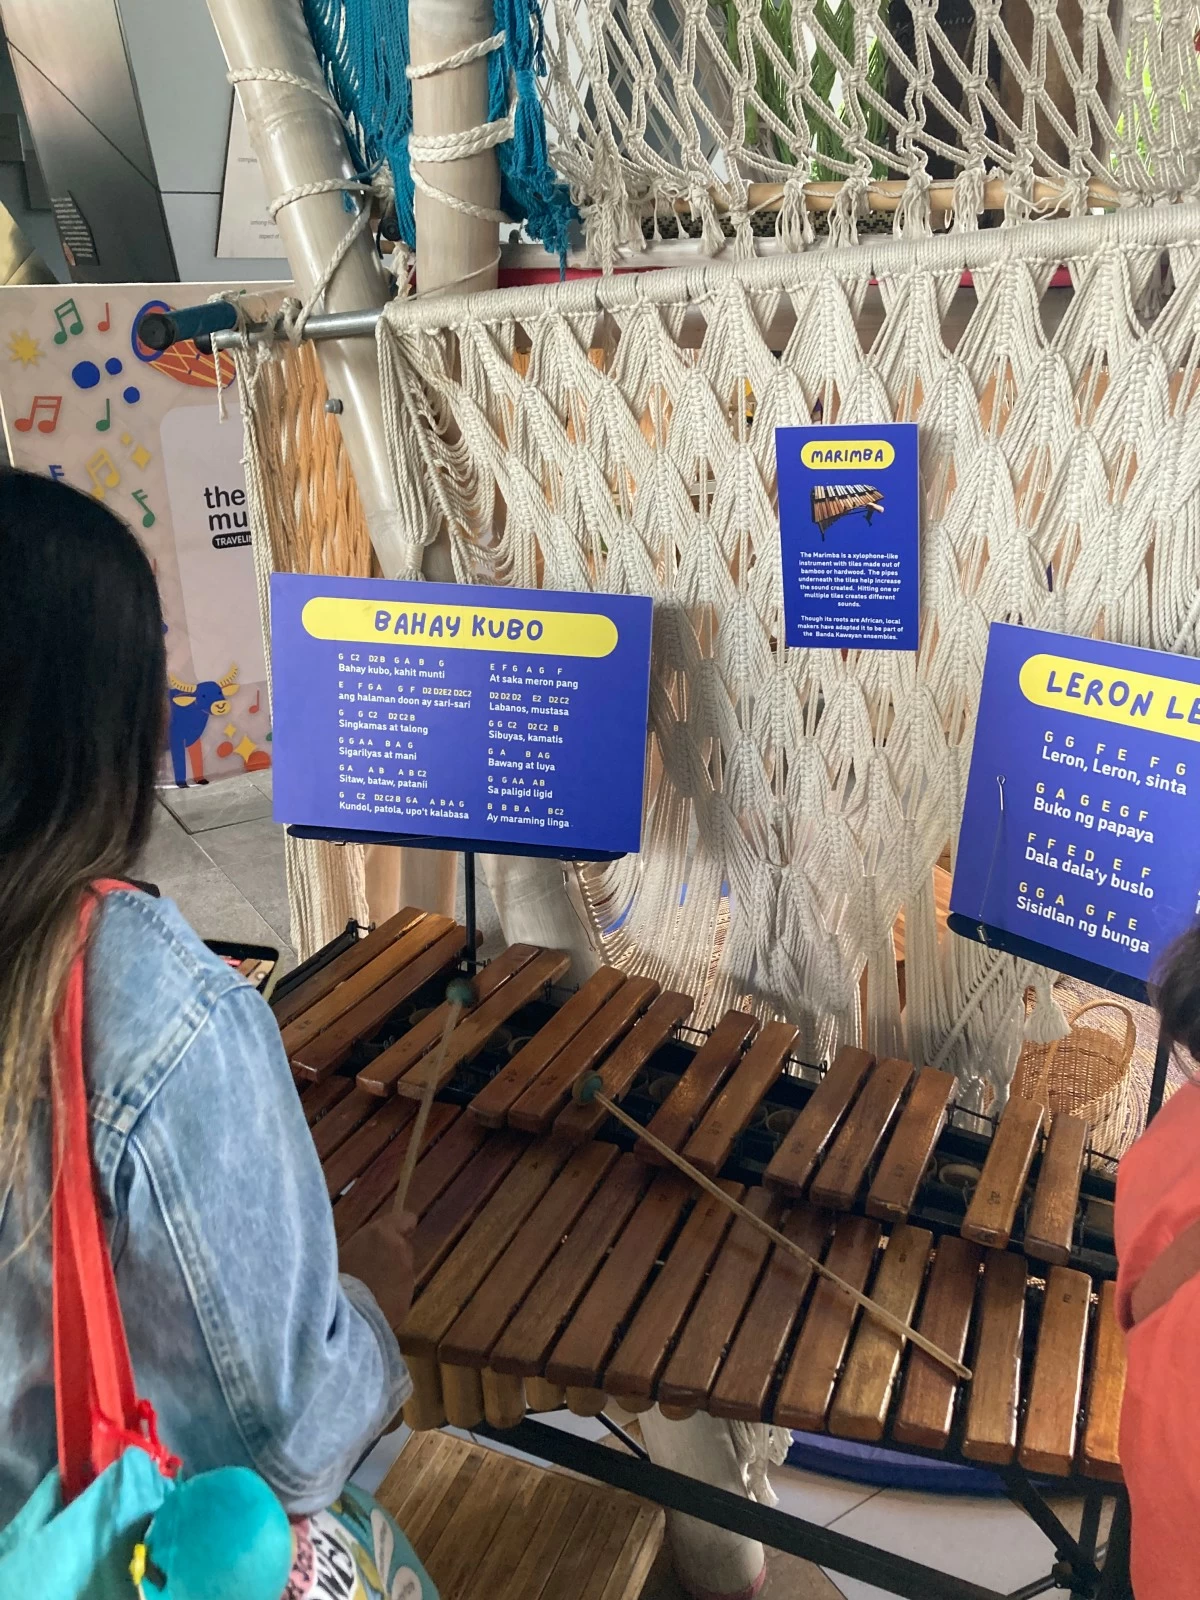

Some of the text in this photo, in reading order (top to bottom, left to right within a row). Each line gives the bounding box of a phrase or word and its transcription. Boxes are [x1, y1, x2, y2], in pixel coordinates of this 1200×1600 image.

[811, 449, 883, 463] MARIMBA
[204, 486, 245, 508] the
[209, 511, 247, 531] mu
[215, 535, 252, 546] TRAVELI
[374, 610, 543, 641] BAHAY KUBO
[339, 664, 366, 674] Bahay
[368, 666, 392, 676] kubo,
[394, 668, 416, 676] kahit
[490, 674, 578, 690] At saka meron pang
[339, 693, 470, 708] ang halaman doon ay sari-sari
[1047, 670, 1153, 717] LERON
[490, 702, 569, 715] Labanos, mustasa
[339, 720, 387, 730] Singkamas
[401, 724, 428, 735] talong
[489, 731, 563, 743] Sibuyas, kamatis
[339, 747, 381, 758] Sigarilyas
[1045, 731, 1186, 775] G G F E F G
[488, 758, 555, 772] Bawang at luya
[1042, 746, 1187, 795] Leron, Leron, sinta
[488, 786, 552, 799] Sa paligid ligid
[1036, 783, 1148, 822] G A G E G F
[430, 809, 469, 819] kalabasa
[487, 813, 569, 828] Ay maraming linga
[1034, 797, 1154, 843] Buko ng papaya
[1028, 832, 1151, 878] F F E D E F
[1025, 847, 1153, 898] Dala dala'y buslo
[1019, 882, 1137, 930] G G A G F E
[1017, 896, 1150, 953] Sisidlan ng bunga
